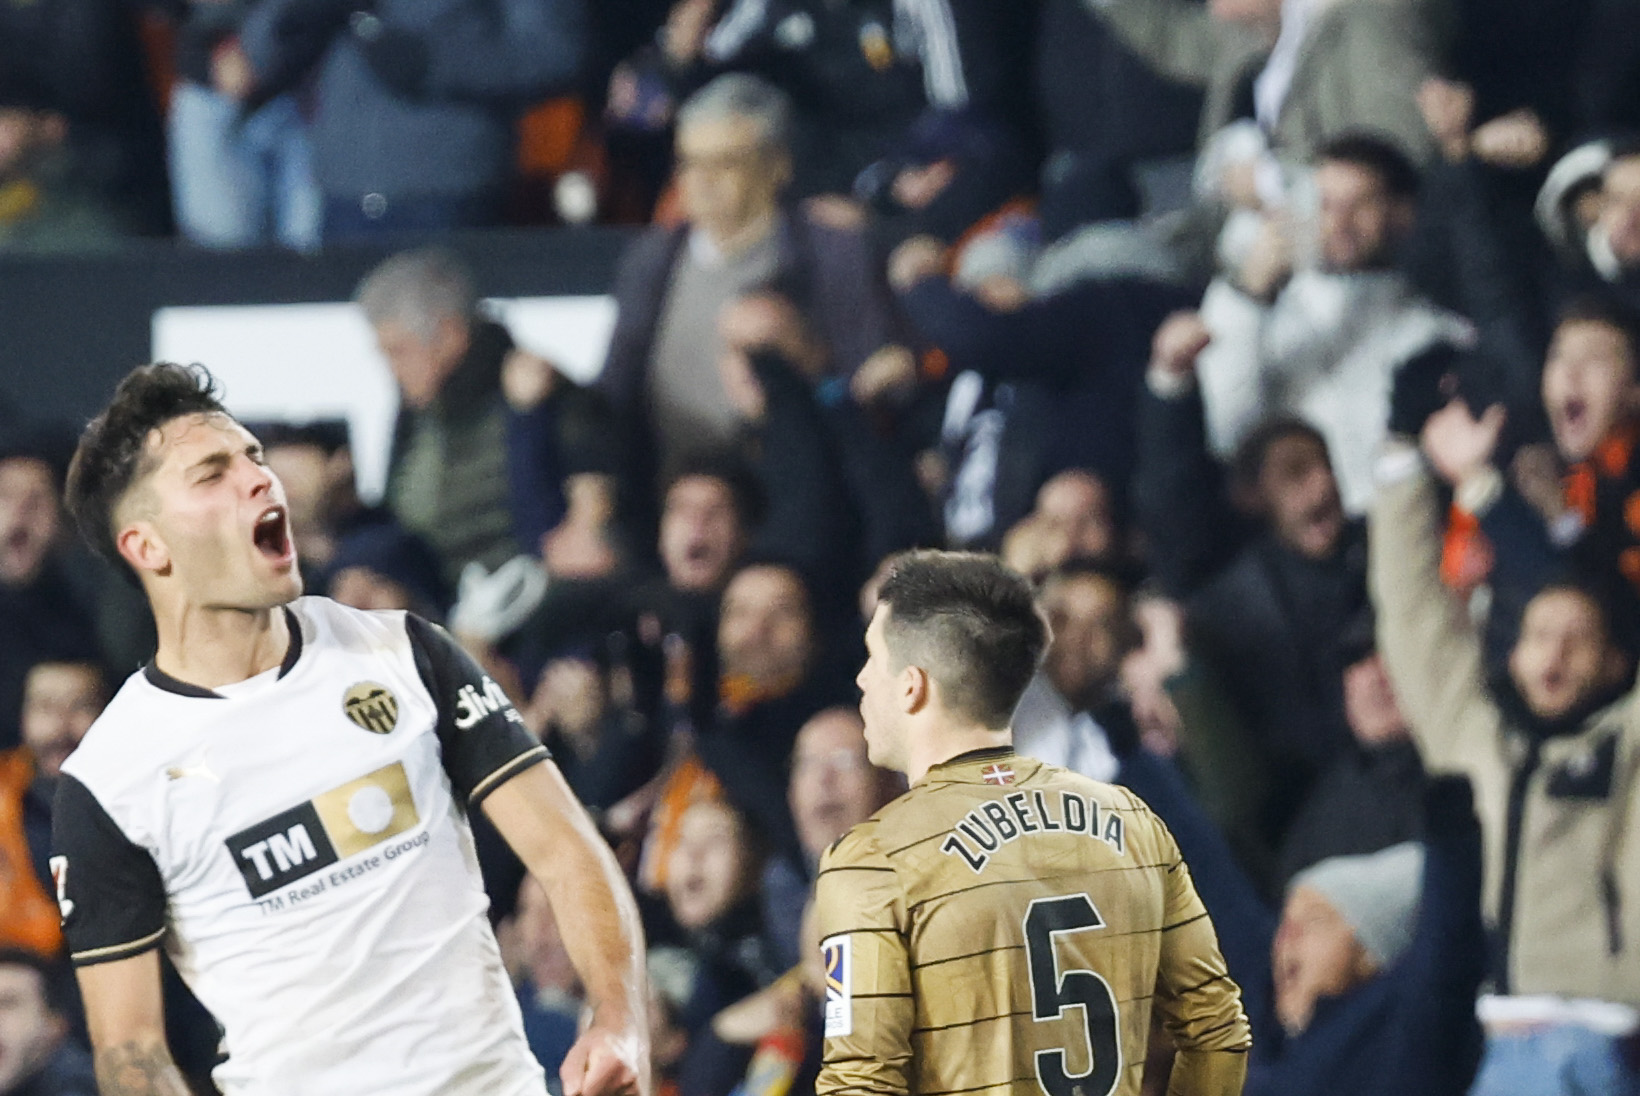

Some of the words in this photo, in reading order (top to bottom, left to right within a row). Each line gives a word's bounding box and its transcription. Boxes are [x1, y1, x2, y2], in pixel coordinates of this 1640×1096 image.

[241, 823, 317, 881] TM
[288, 880, 325, 905] Real
[329, 857, 380, 887] Estate
[383, 831, 430, 861] Group
[941, 790, 1124, 874] ZUBELDIA
